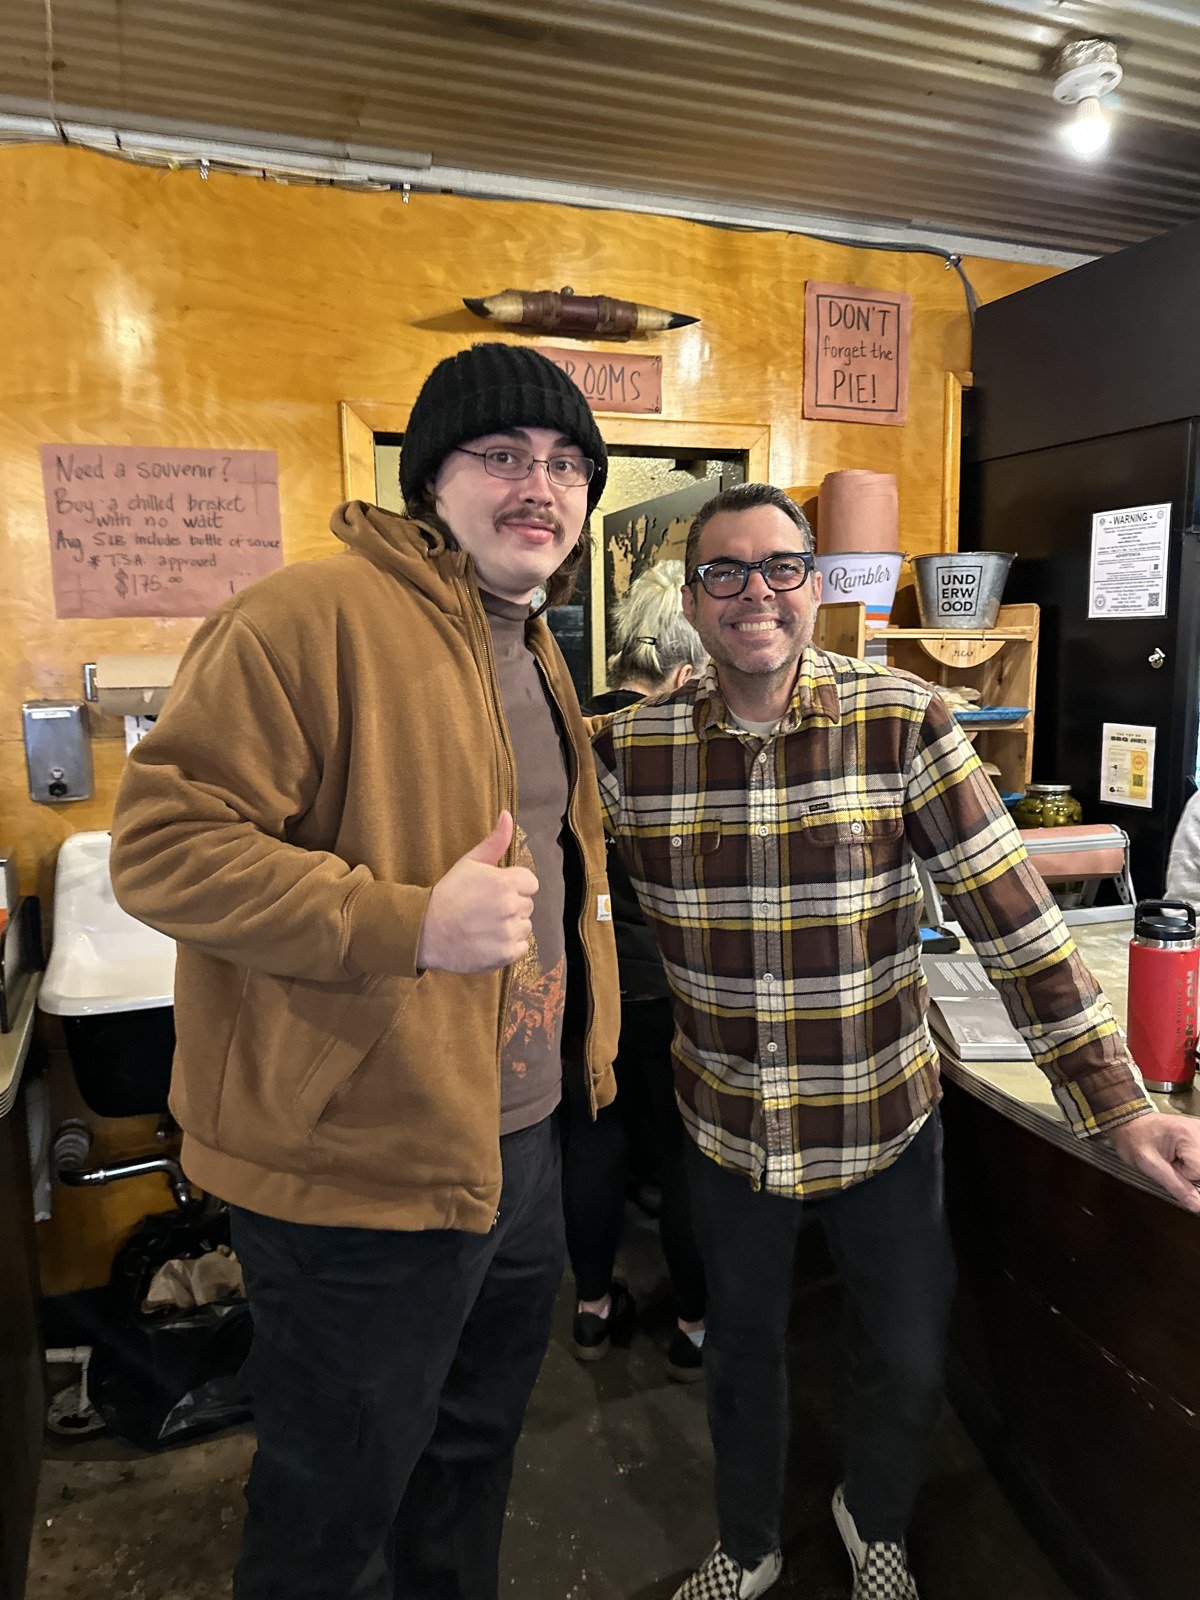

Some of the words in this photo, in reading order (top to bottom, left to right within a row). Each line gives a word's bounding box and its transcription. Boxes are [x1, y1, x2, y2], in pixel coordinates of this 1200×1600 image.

[829, 300, 890, 337] DON'T
[823, 335, 867, 366] forget
[871, 342, 894, 361] the
[554, 361, 641, 402] ROOMS
[833, 369, 877, 404] PIE!
[56, 453, 104, 483] Need
[114, 462, 126, 478] a
[136, 457, 232, 482] souvenir?
[53, 487, 96, 524] Buy
[106, 498, 119, 511] a
[128, 493, 174, 512] chilled
[187, 493, 246, 512] brisket
[96, 511, 132, 528] with
[144, 515, 169, 528] no
[182, 511, 224, 528] wait
[1113, 512, 1148, 525] WARNING
[134, 531, 181, 546] includes
[188, 533, 222, 546] bottle
[229, 535, 242, 548] of
[158, 553, 217, 572] approved
[828, 564, 891, 594] Rambler
[941, 574, 976, 586] UND
[942, 587, 975, 599] ERW
[941, 601, 973, 612] OOD
